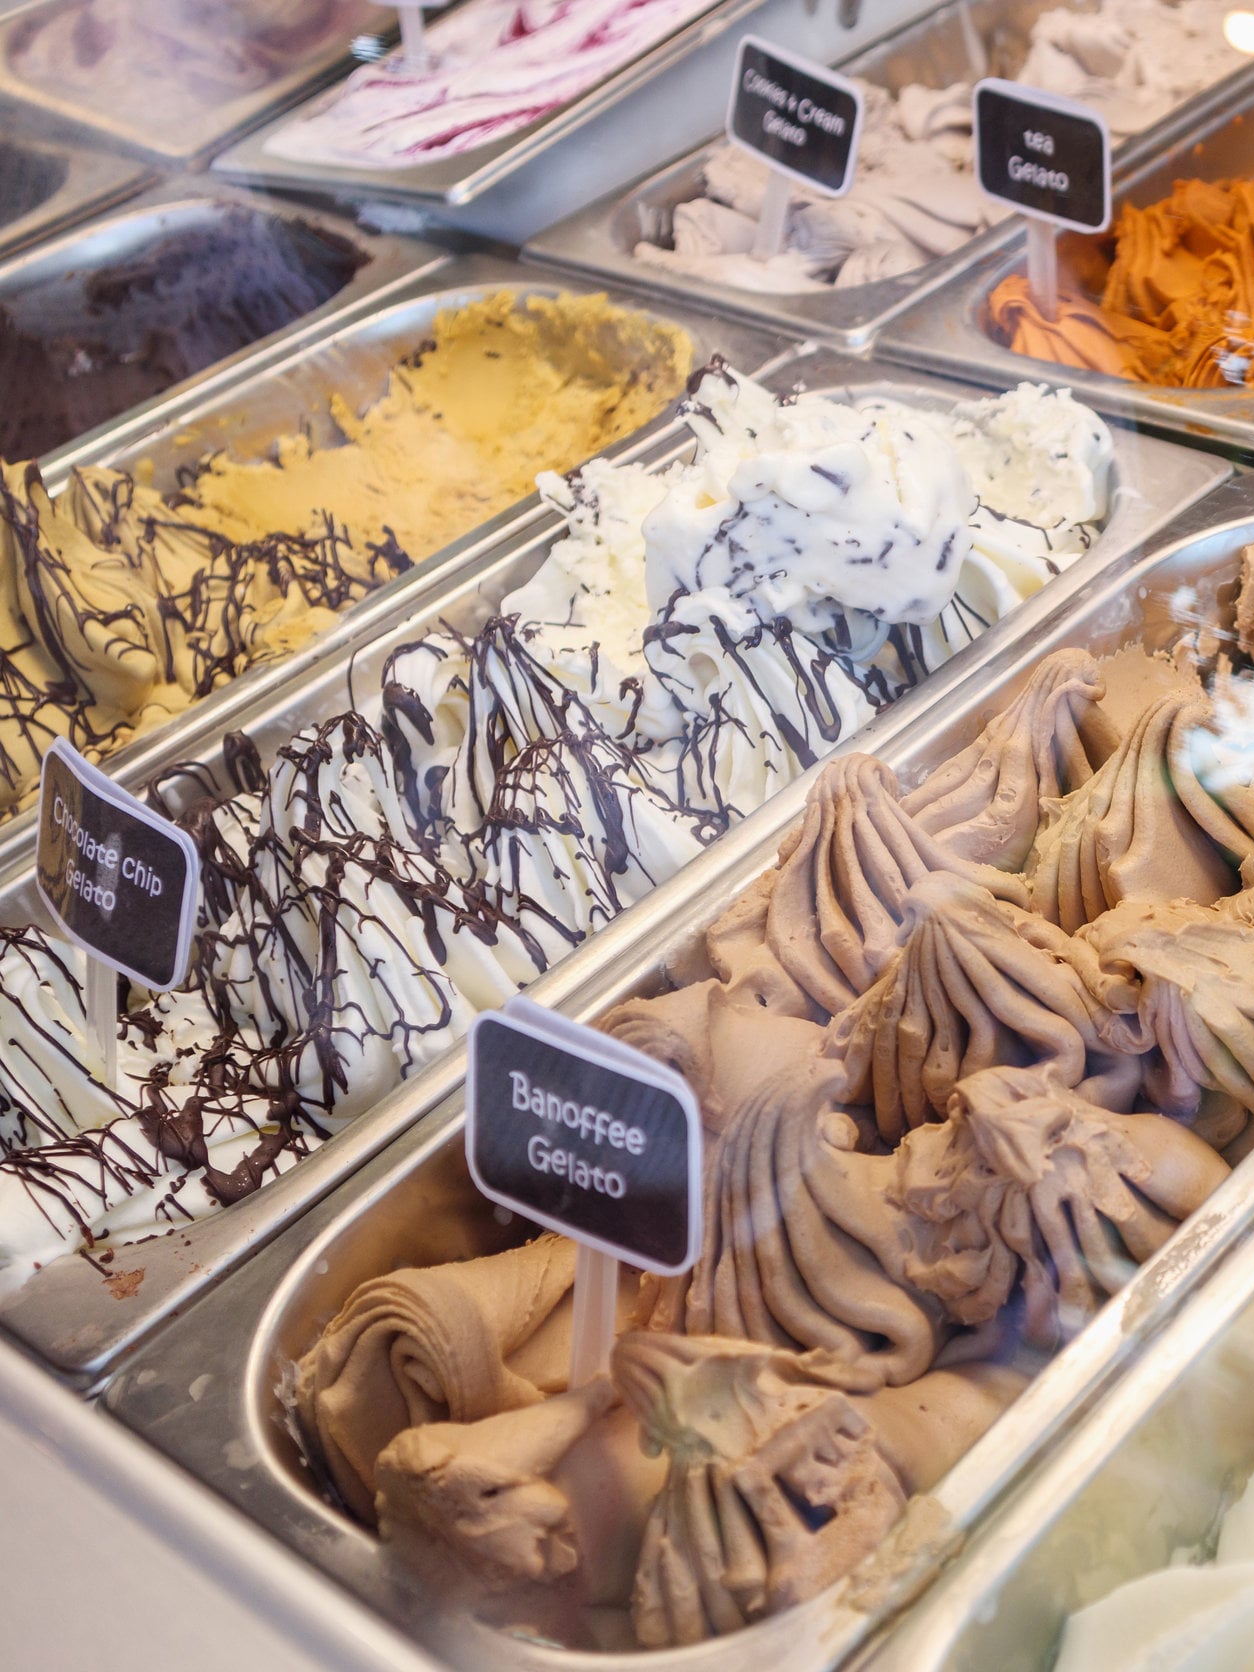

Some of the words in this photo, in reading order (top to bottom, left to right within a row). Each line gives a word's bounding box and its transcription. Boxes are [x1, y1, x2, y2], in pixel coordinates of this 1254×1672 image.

[762, 110, 808, 147] Gelato
[797, 98, 846, 137] Cream
[1023, 129, 1055, 156] tea
[1007, 155, 1070, 192] Gelato
[53, 797, 118, 869] Chocolate
[66, 858, 116, 911] Gelato
[509, 1071, 646, 1155] Banoffee
[527, 1135, 626, 1198] Gelato
